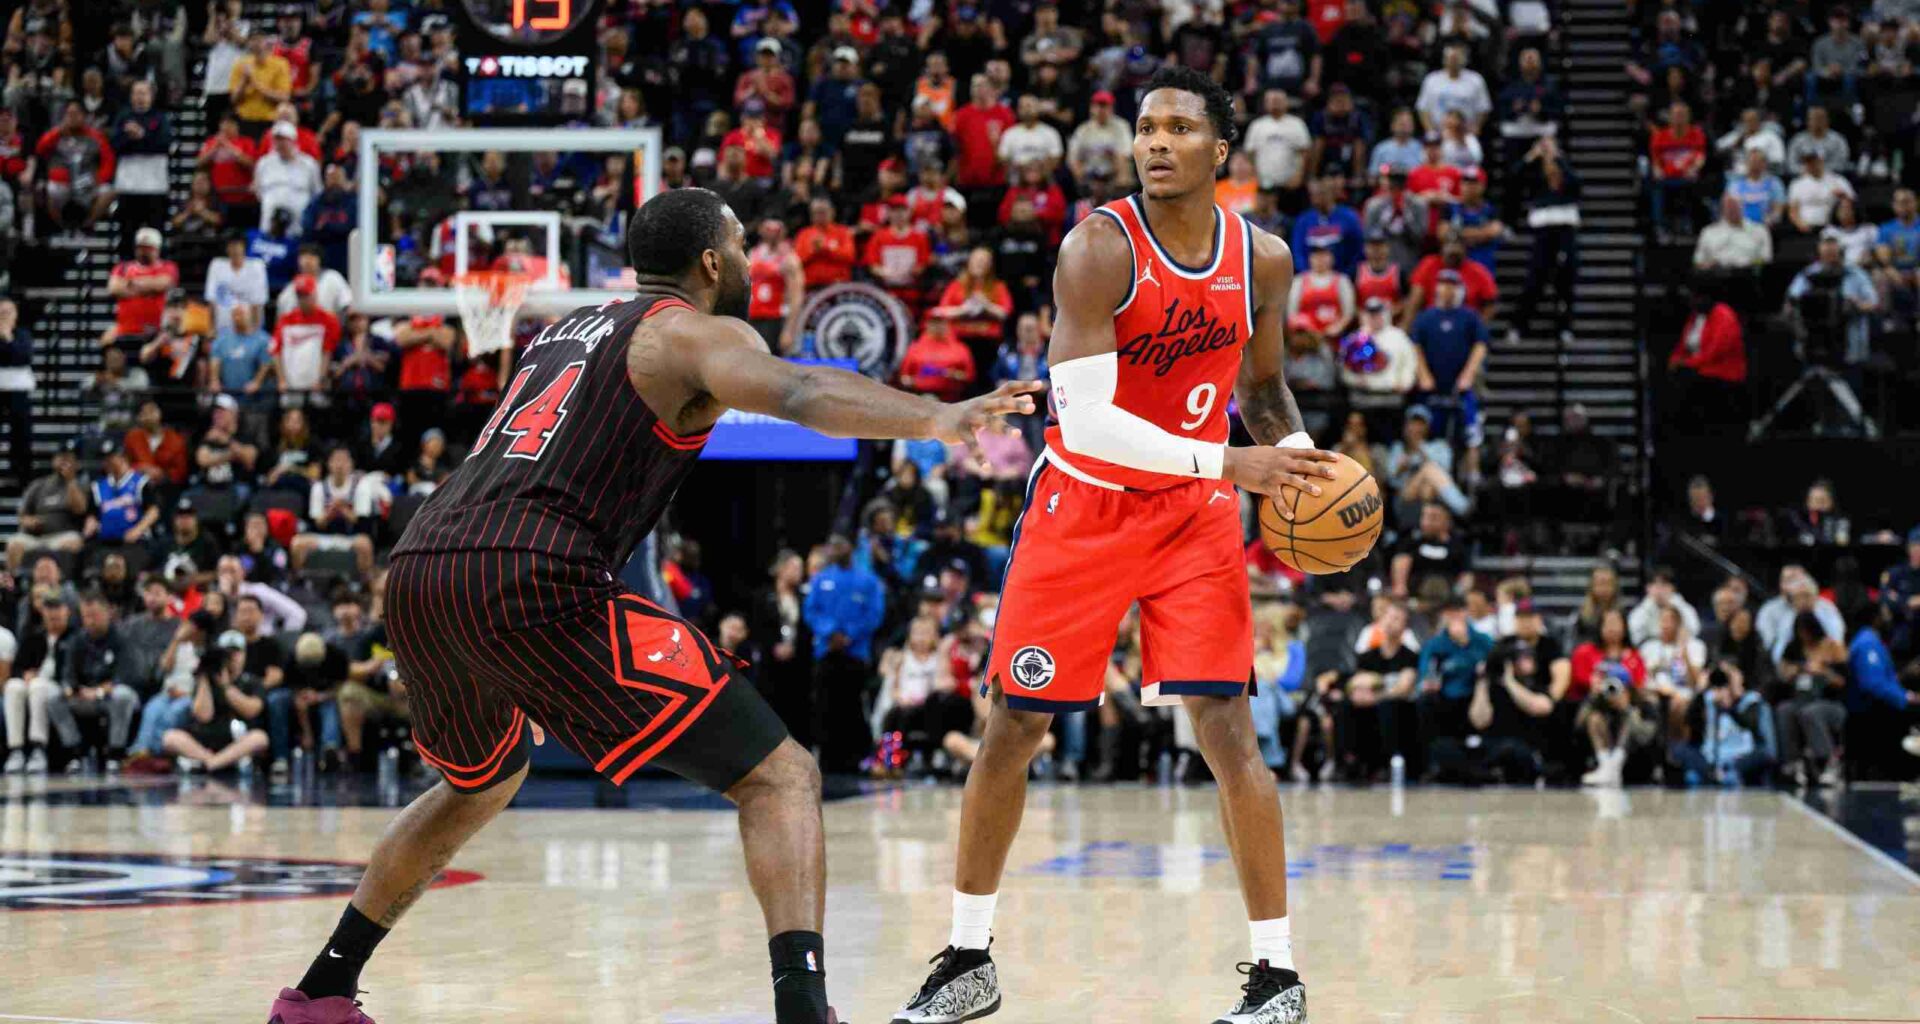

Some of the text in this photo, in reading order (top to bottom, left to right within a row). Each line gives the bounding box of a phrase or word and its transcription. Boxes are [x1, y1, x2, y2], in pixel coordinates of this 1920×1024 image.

[499, 55, 589, 77] TISSOT
[1210, 283, 1242, 291] RWANDA
[1157, 298, 1208, 338] Los
[1117, 317, 1237, 377] Angeles
[464, 360, 586, 462] 14
[1180, 382, 1217, 431] 9
